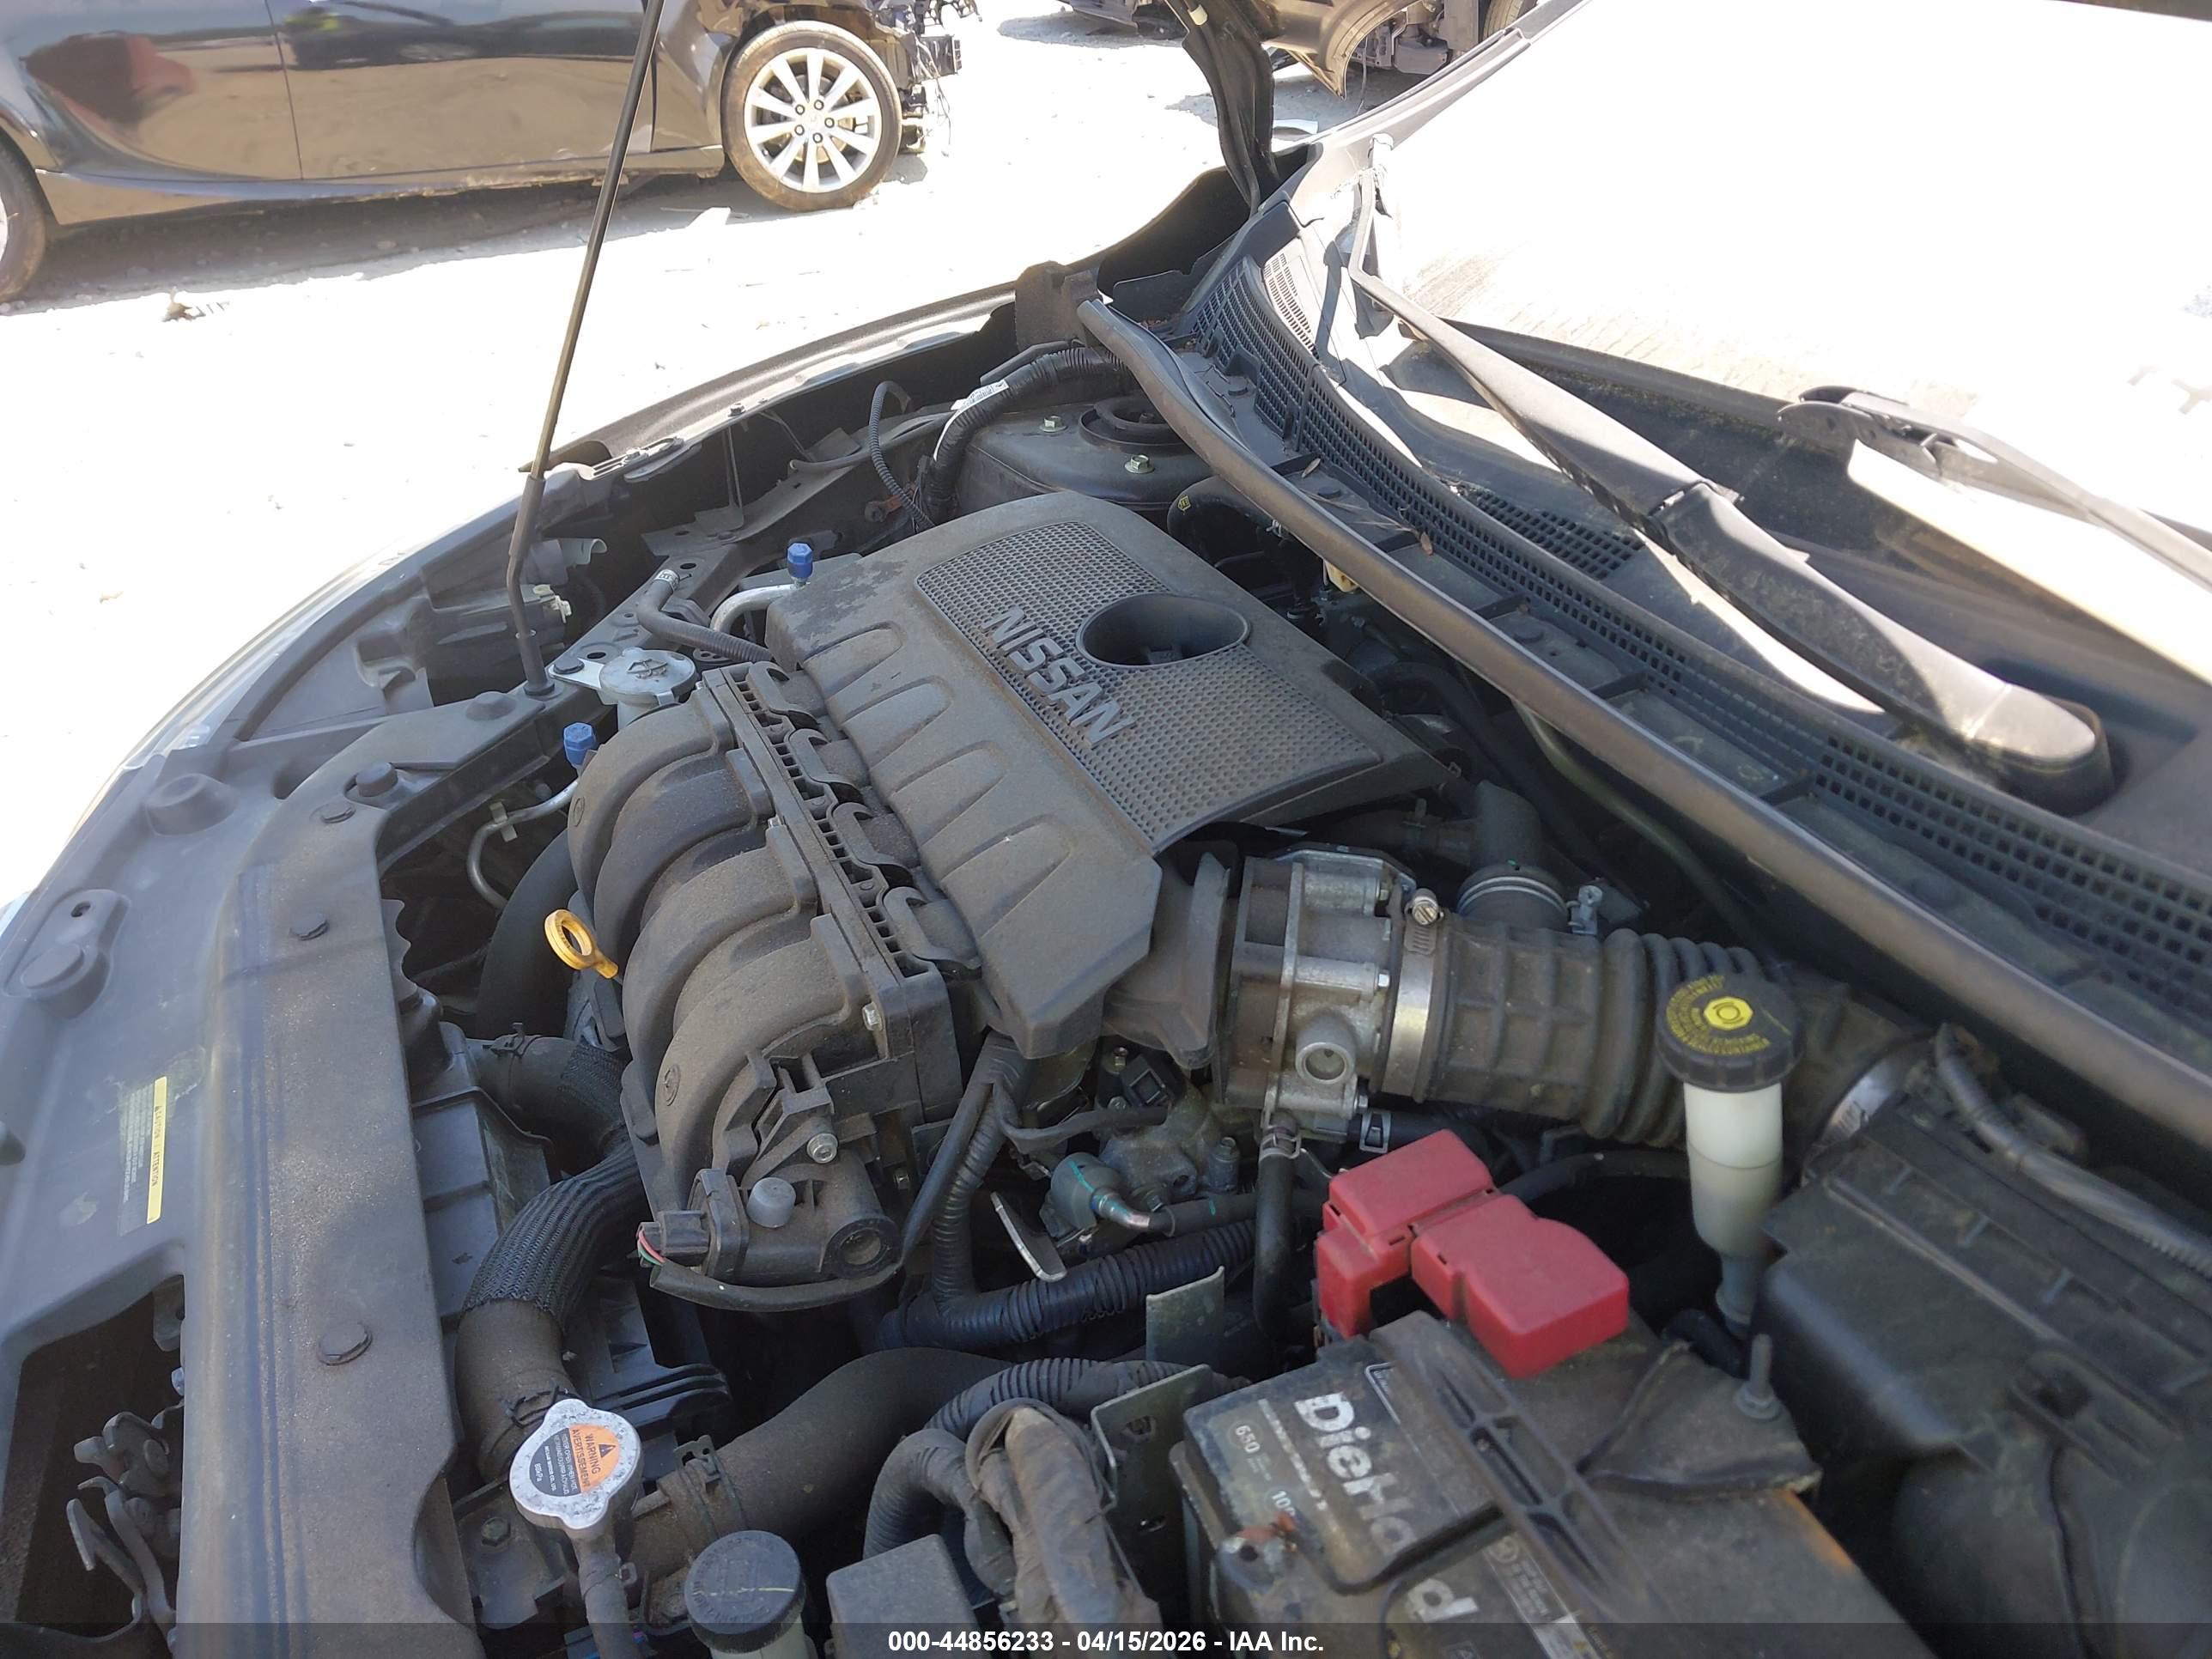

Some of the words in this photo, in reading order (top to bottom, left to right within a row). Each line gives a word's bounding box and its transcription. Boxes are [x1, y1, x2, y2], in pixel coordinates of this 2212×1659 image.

[981, 605, 1137, 747] NISSAN
[152, 1152, 161, 1186] ATTENTION
[572, 1429, 591, 1487] AVERTISSEMENT
[585, 1434, 601, 1474] WARNING
[1236, 1425, 1261, 1453] 650
